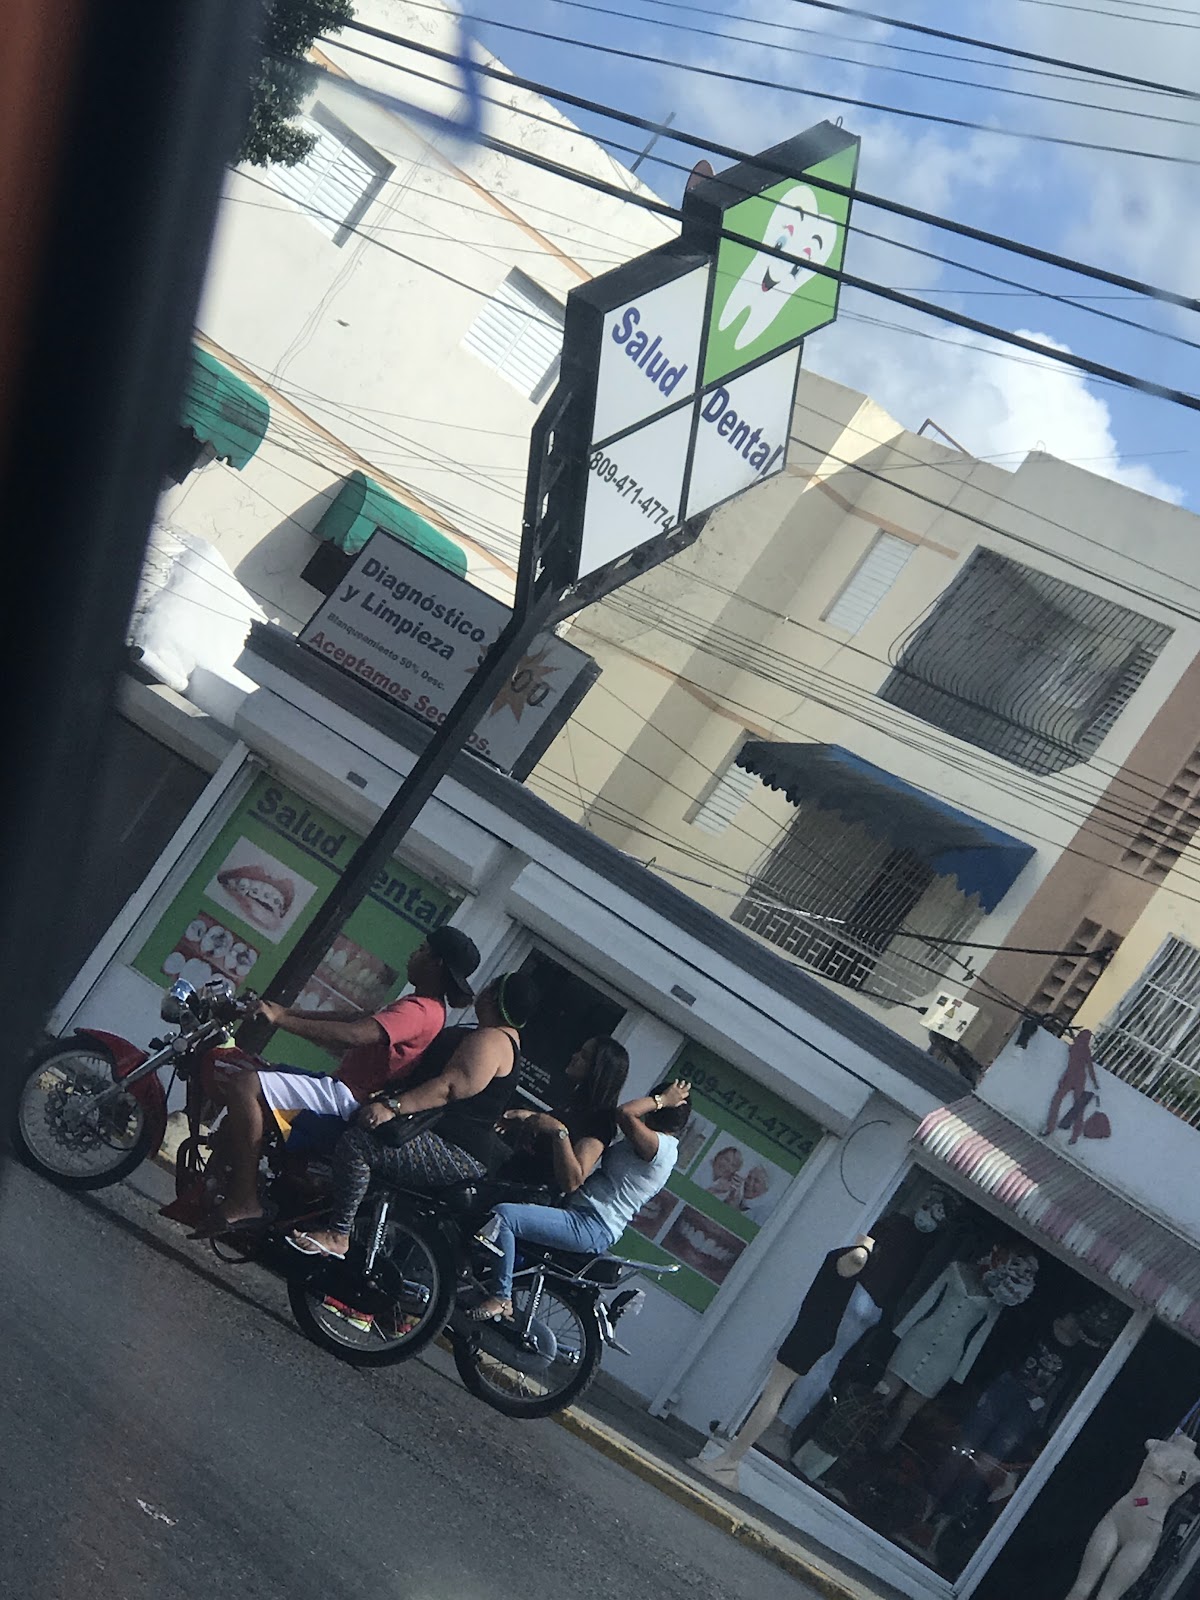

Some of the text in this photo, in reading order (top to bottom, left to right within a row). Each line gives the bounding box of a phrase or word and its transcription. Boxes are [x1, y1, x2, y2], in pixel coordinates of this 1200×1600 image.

[611, 306, 785, 476] Salud Dental
[589, 451, 676, 530] 809-471-4774
[339, 583, 456, 661] y Limpieza
[361, 557, 486, 644] Diagnóstico
[308, 631, 413, 703] Aceptamos
[256, 786, 453, 929] Salud ental
